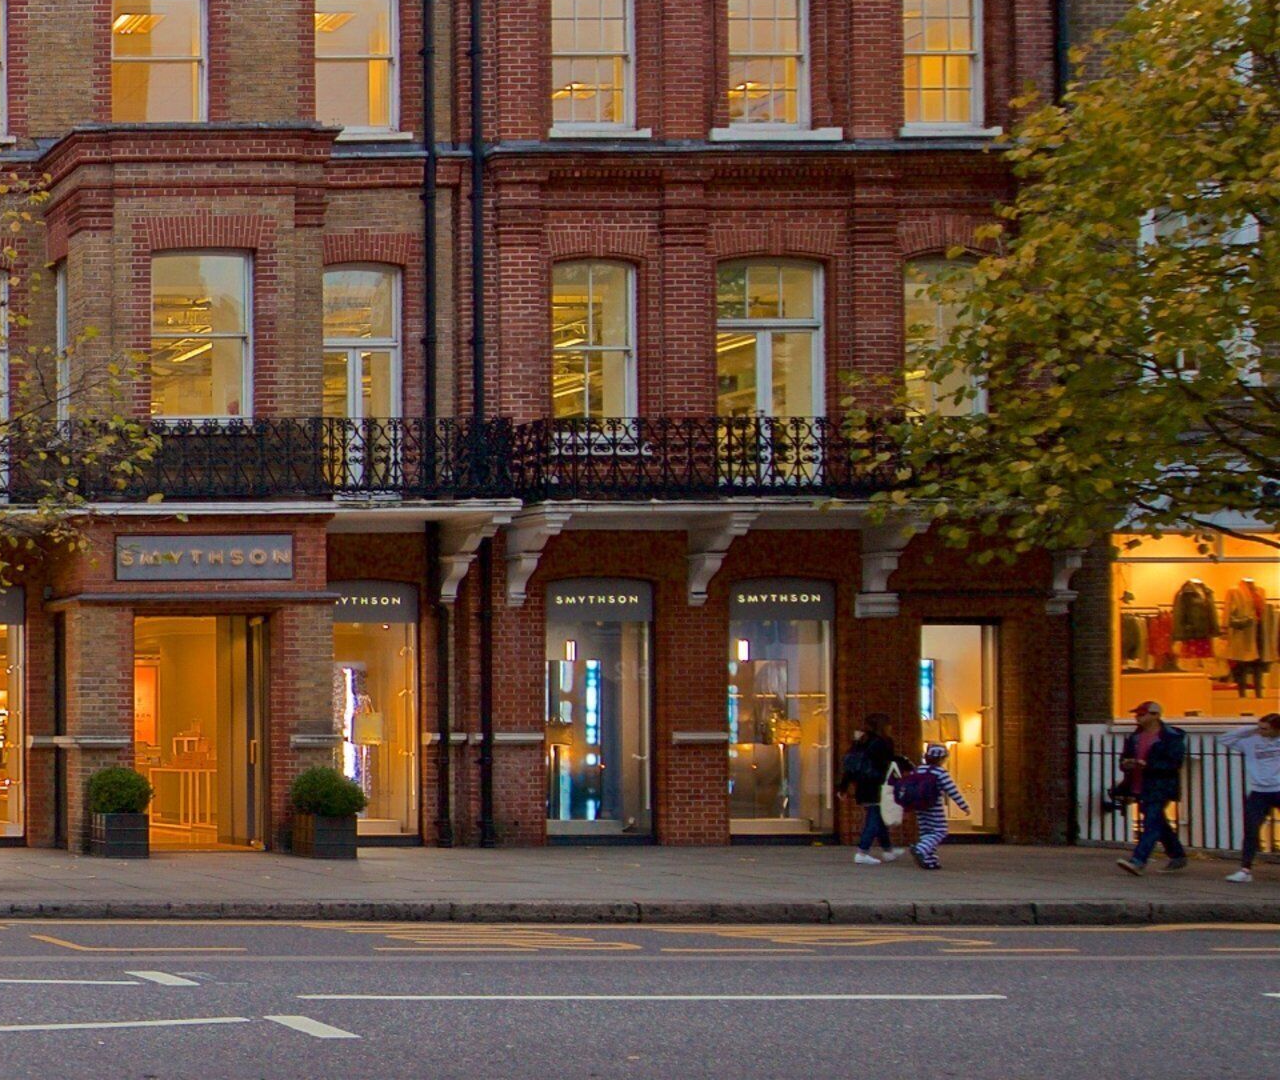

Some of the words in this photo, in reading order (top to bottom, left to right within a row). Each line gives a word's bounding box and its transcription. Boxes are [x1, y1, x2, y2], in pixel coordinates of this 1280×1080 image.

[120, 548, 290, 566] SMYTHSON
[335, 596, 401, 605] YTHSON
[555, 595, 639, 604] SMYTHSON
[737, 594, 821, 603] SMYTHSON
